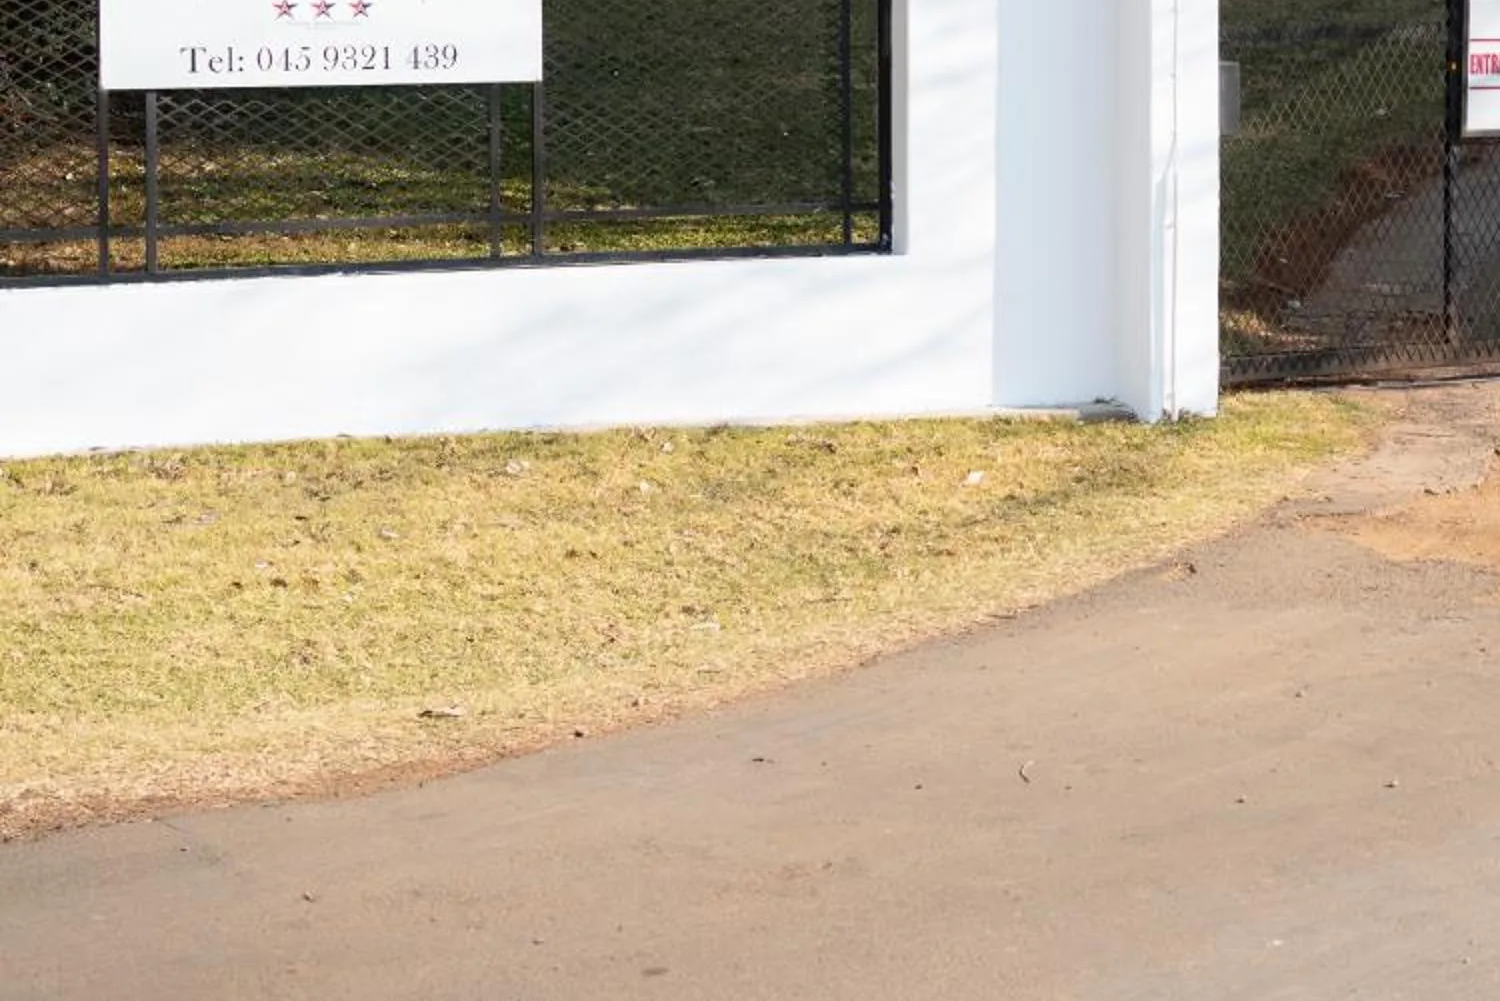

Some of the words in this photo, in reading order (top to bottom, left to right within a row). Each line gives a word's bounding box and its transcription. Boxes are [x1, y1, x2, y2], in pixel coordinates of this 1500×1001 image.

[180, 47, 244, 74] Tel:
[256, 46, 311, 72] 045
[322, 46, 391, 71] 9321
[407, 44, 459, 70] 439
